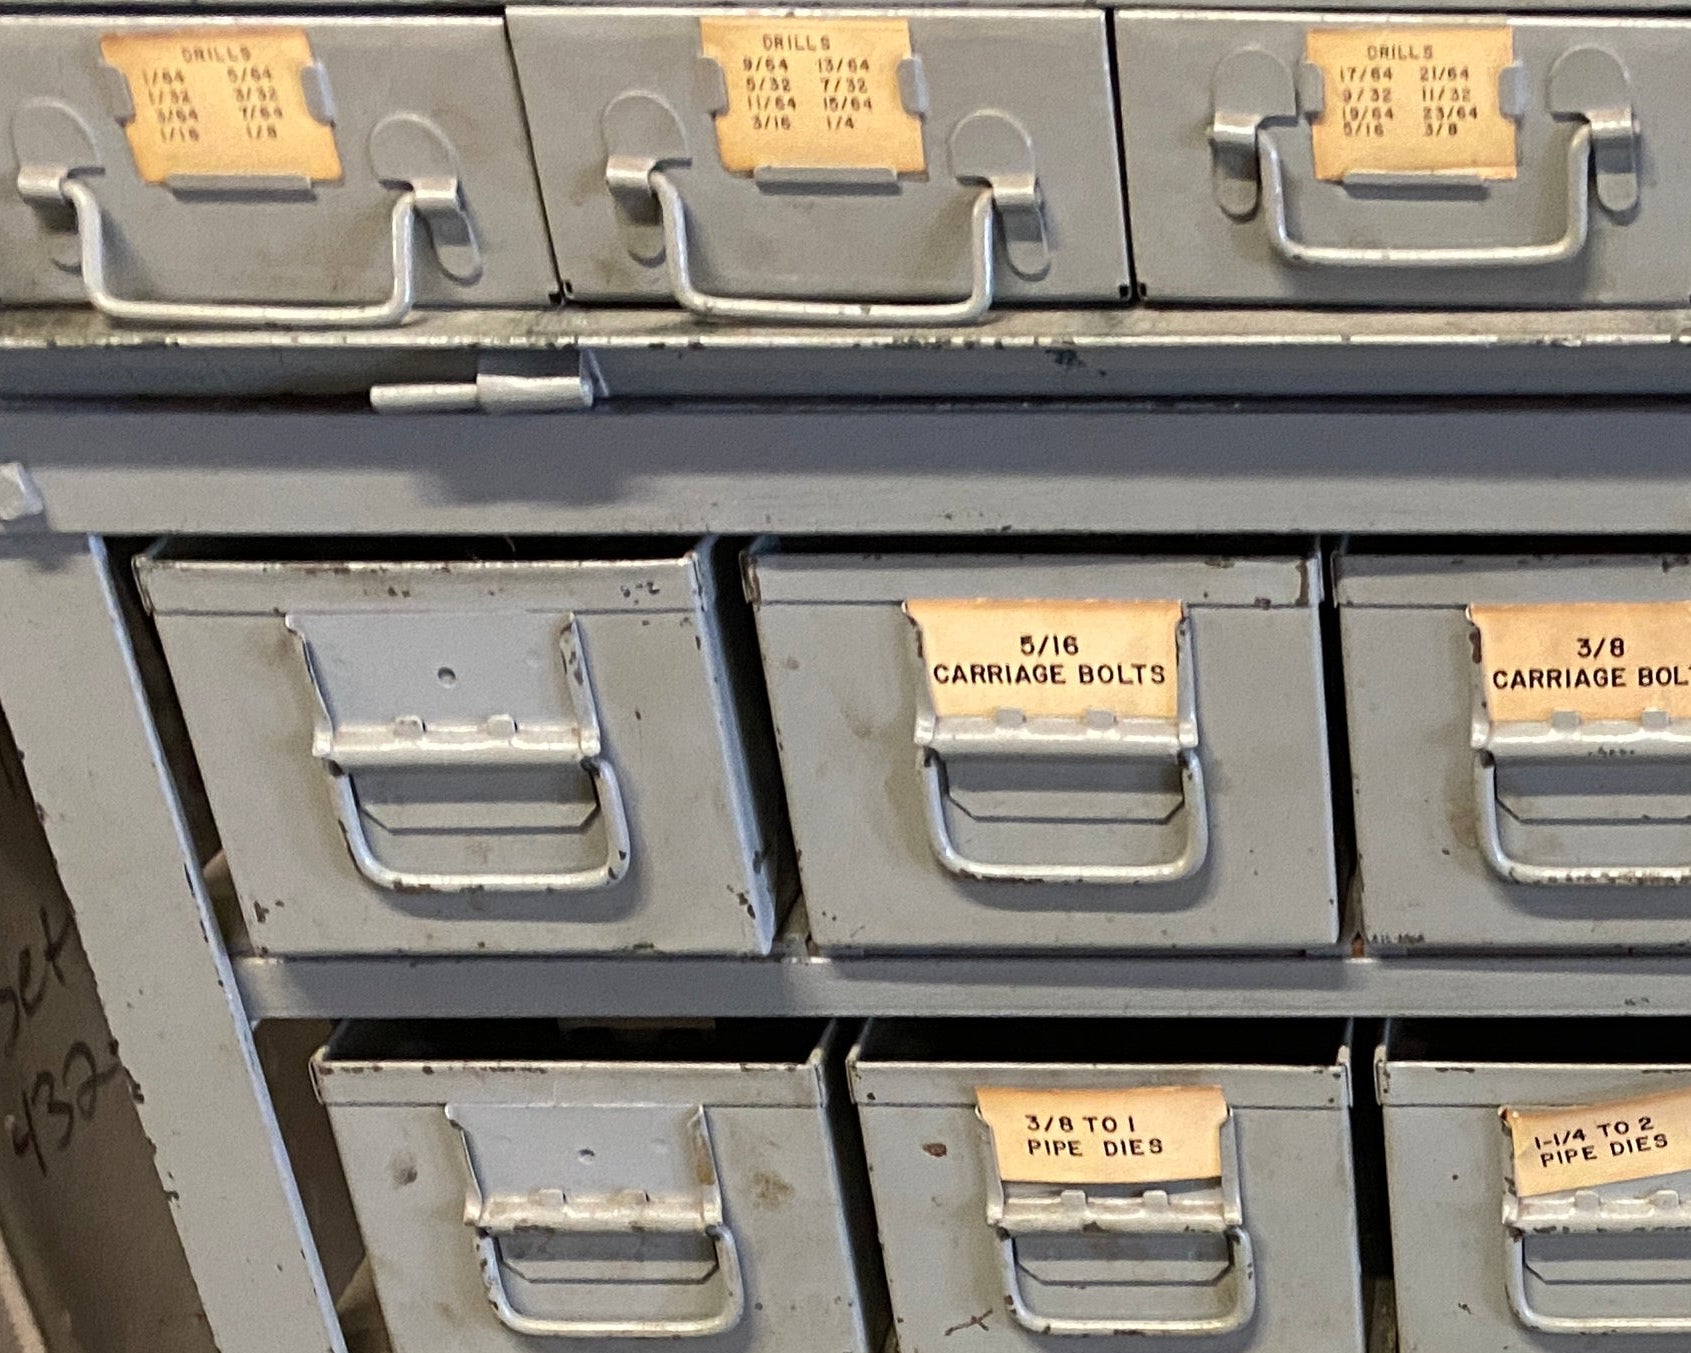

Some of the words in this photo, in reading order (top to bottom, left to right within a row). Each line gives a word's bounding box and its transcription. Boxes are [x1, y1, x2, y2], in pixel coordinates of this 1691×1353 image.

[763, 34, 830, 51] DRILLS
[182, 46, 251, 63] DRILLS
[1368, 44, 1434, 60] DRILLS
[743, 56, 788, 72] 9/64
[817, 57, 869, 73] 13/64
[1339, 66, 1393, 83] 17/64
[1420, 66, 1469, 81] 21/64
[746, 77, 791, 92] 5/32
[821, 77, 867, 93] 7/32
[1421, 86, 1471, 102] 11/32
[747, 95, 796, 112] 11/64
[823, 96, 873, 113] 15/64
[753, 115, 791, 130] 3/16
[826, 115, 854, 130] 1/4
[1343, 106, 1394, 122] 19/64
[1423, 106, 1478, 121] 23/64
[1020, 634, 1079, 658] 5/16
[1577, 638, 1624, 660] 3/8
[933, 663, 1066, 685] CARRIAGE
[1078, 663, 1166, 685] BOLTS
[1492, 668, 1626, 690] CARRIAGE
[1025, 1114, 1073, 1133] 3/8
[1082, 1116, 1117, 1133] TO
[1535, 1128, 1586, 1150] 1-1/4
[1597, 1121, 1629, 1137] TO
[1638, 1116, 1654, 1131] 2
[1027, 1139, 1083, 1157] PIPE
[1104, 1138, 1163, 1157] DIES
[1541, 1145, 1598, 1168] PIPE
[1610, 1133, 1668, 1156] DIES
